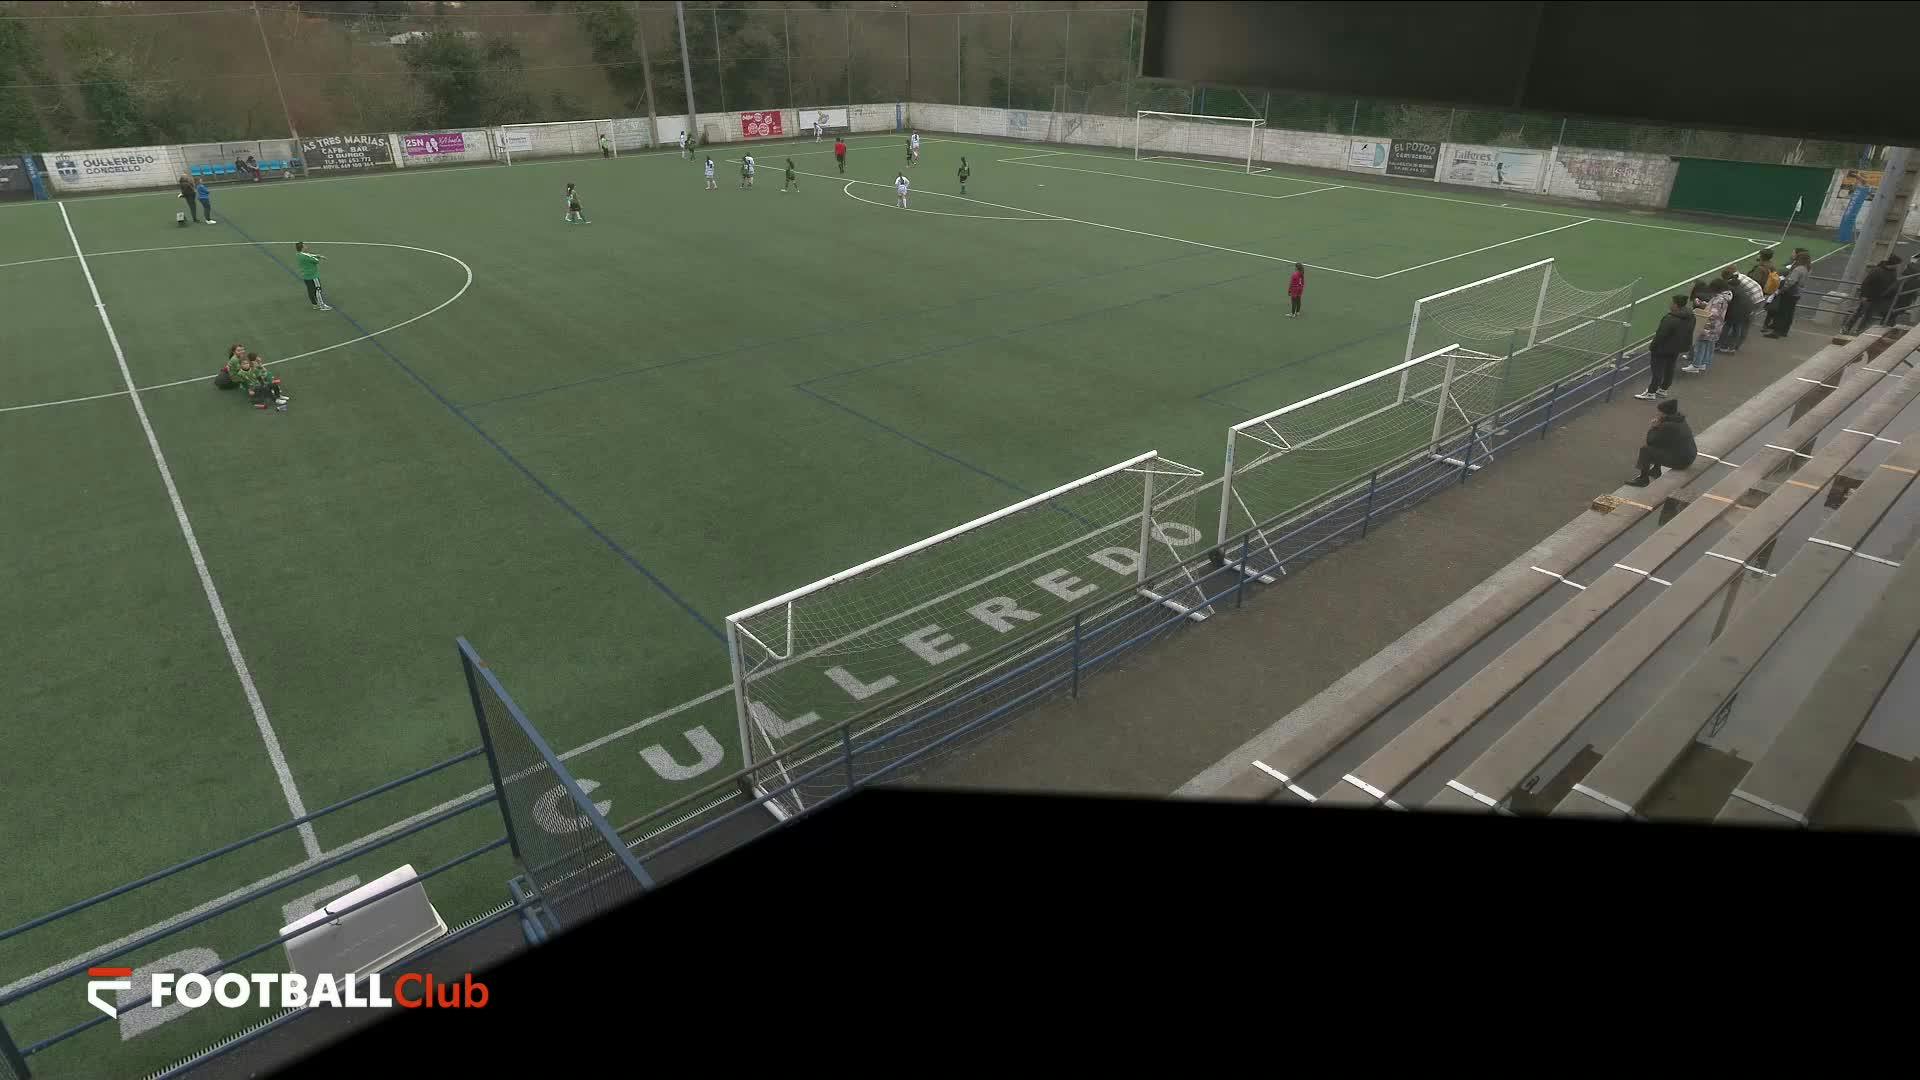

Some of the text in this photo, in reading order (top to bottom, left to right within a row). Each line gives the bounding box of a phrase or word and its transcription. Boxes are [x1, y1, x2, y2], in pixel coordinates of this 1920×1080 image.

[317, 136, 342, 148] TRES
[343, 135, 385, 147] MARIAS
[406, 138, 425, 148] 25N
[350, 145, 369, 153] BAR
[86, 164, 141, 175] CONCELLO
[531, 521, 1204, 836] CULLEREDO
